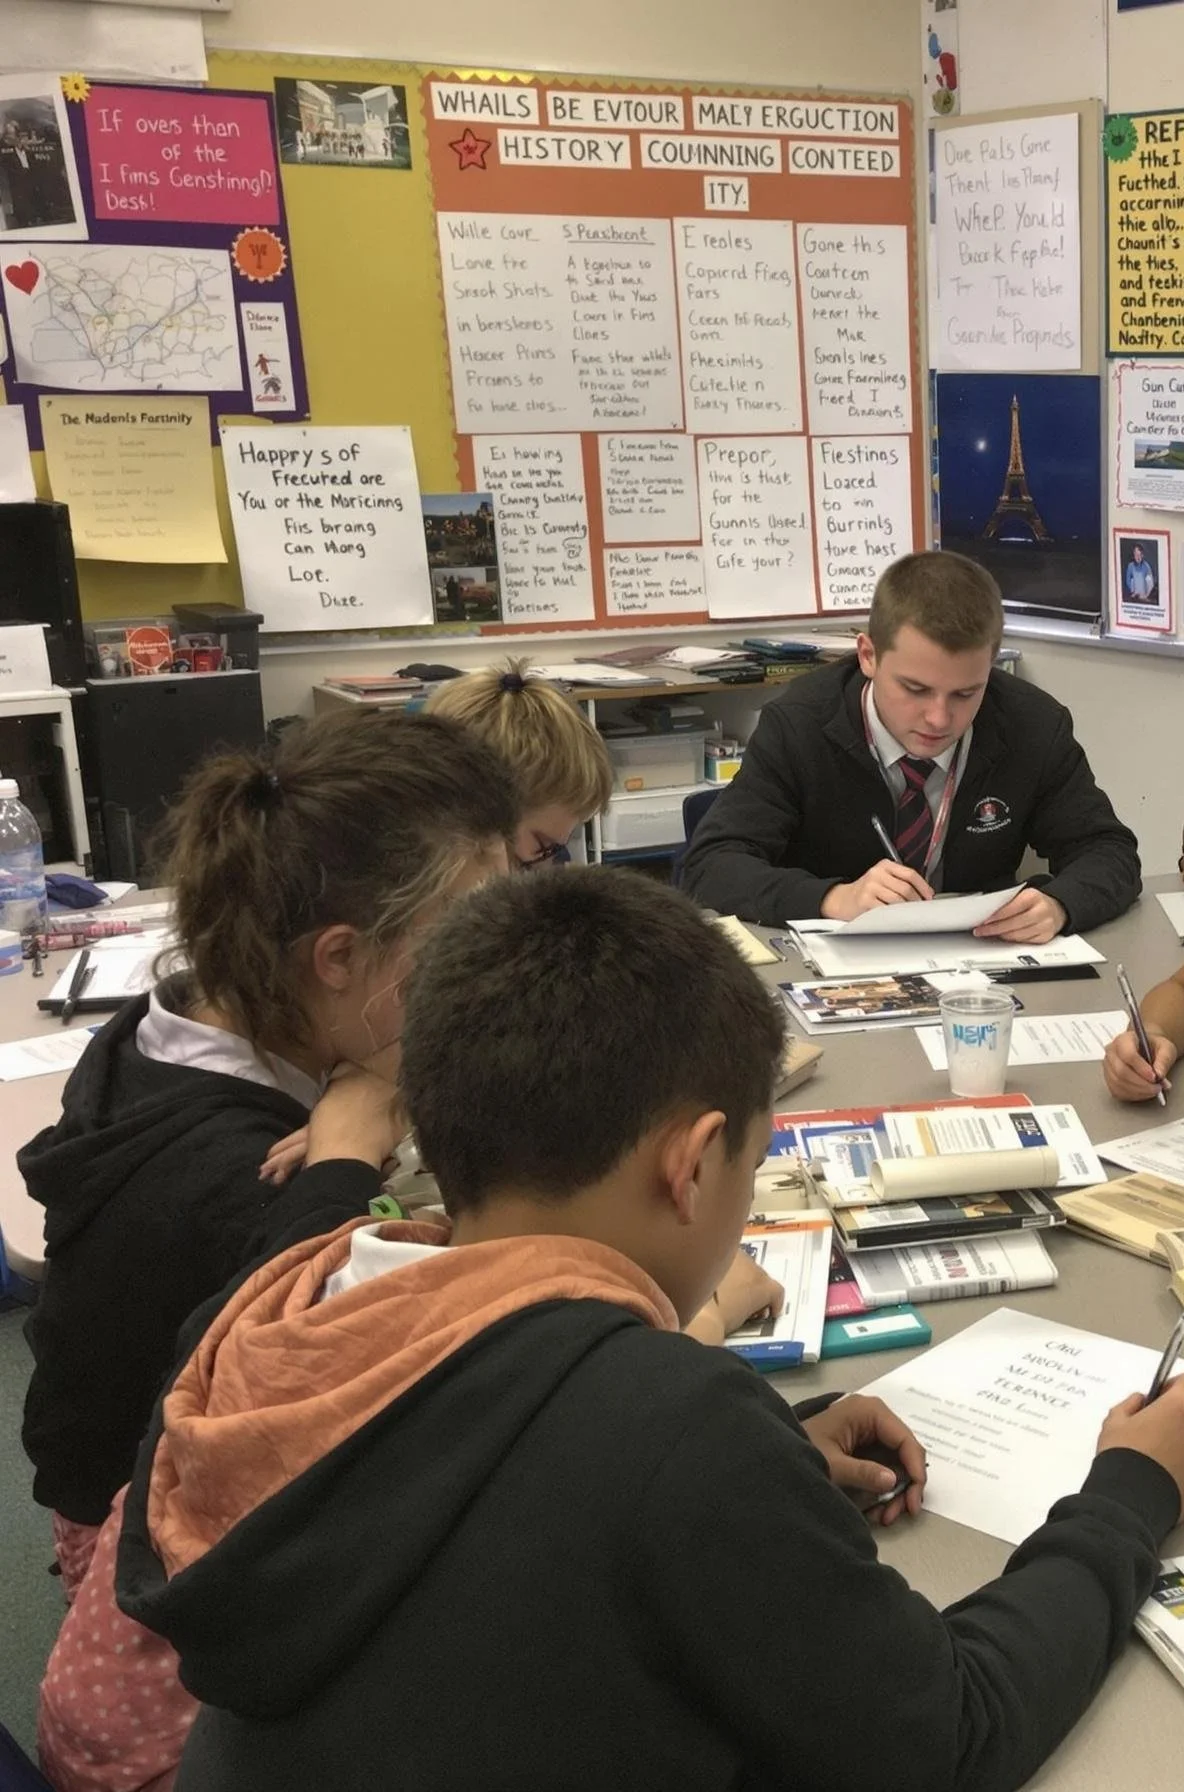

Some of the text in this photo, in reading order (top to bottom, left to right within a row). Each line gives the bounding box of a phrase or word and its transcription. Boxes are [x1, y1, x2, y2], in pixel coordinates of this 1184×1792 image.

[437, 90, 532, 120] WHAILS
[553, 96, 583, 120] BE
[762, 105, 895, 133] ERGUCTION
[161, 143, 228, 162] of the
[503, 135, 624, 163] HISTORY
[1117, 254, 1142, 272] the
[1119, 274, 1143, 291] and
[1120, 291, 1147, 308] and
[296, 492, 321, 510] the
